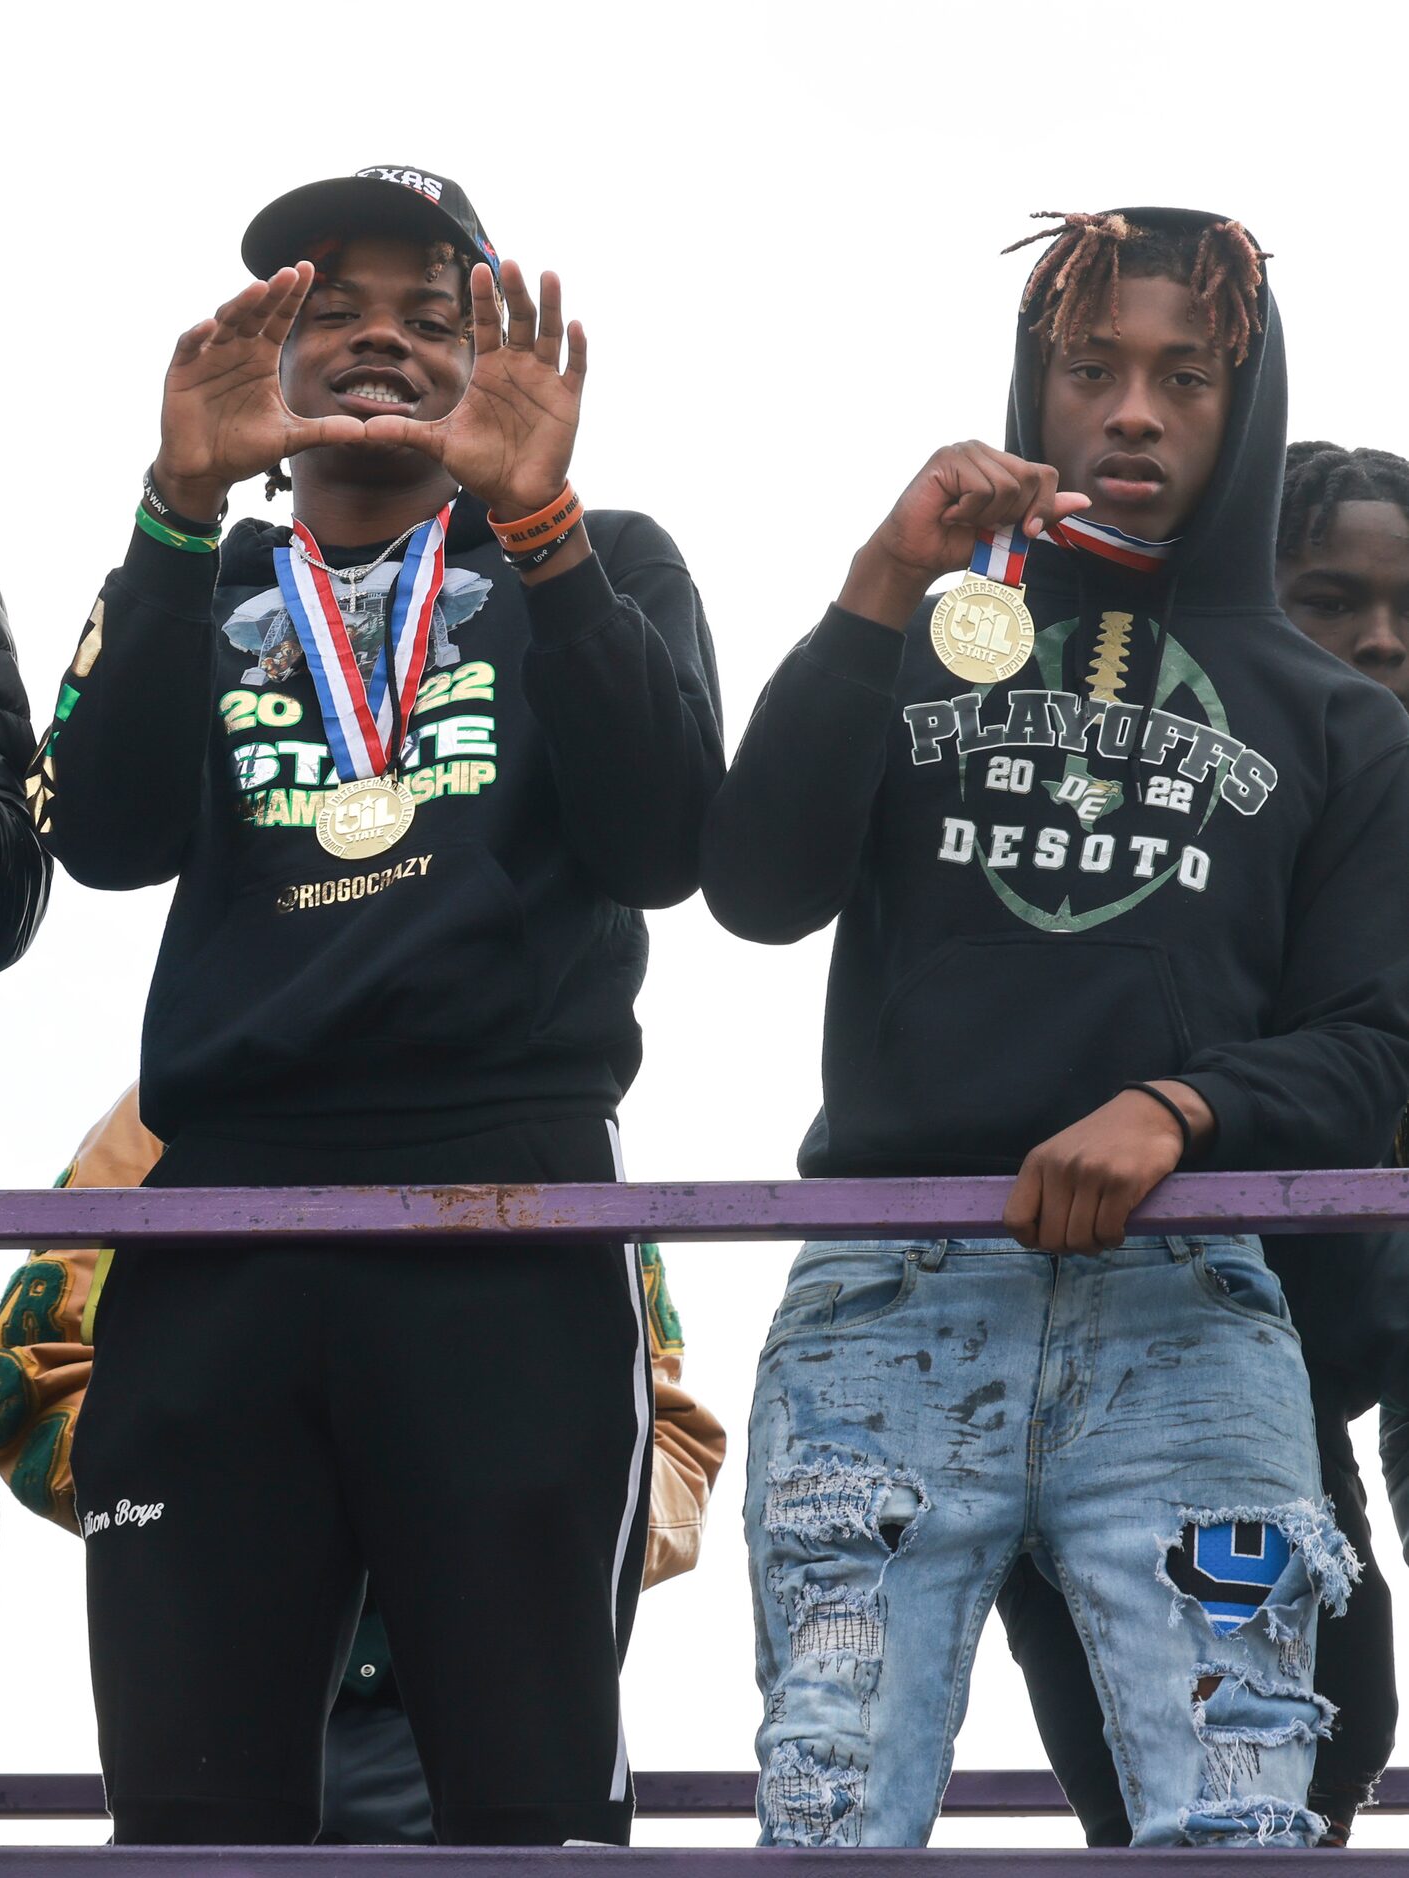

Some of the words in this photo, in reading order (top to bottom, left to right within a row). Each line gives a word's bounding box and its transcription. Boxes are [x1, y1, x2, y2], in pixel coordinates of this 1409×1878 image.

[352, 168, 443, 201] XAS
[149, 492, 169, 515] WAY
[511, 531, 528, 543] ALL
[552, 510, 567, 525] NO
[955, 582, 1033, 633] INTERSCHOLASTIC
[932, 598, 952, 661] UNIVERSITY
[956, 642, 998, 665] STATE
[998, 642, 1031, 677] LEAGUE
[219, 689, 304, 735] 20
[413, 660, 496, 715] 22
[903, 690, 1278, 816] PLAYOFFS
[985, 756, 1035, 795] 20
[1145, 776, 1196, 814] 22
[346, 828, 385, 844] STATE
[937, 816, 1211, 893] DESOTO
[114, 1498, 165, 1528] Boys
